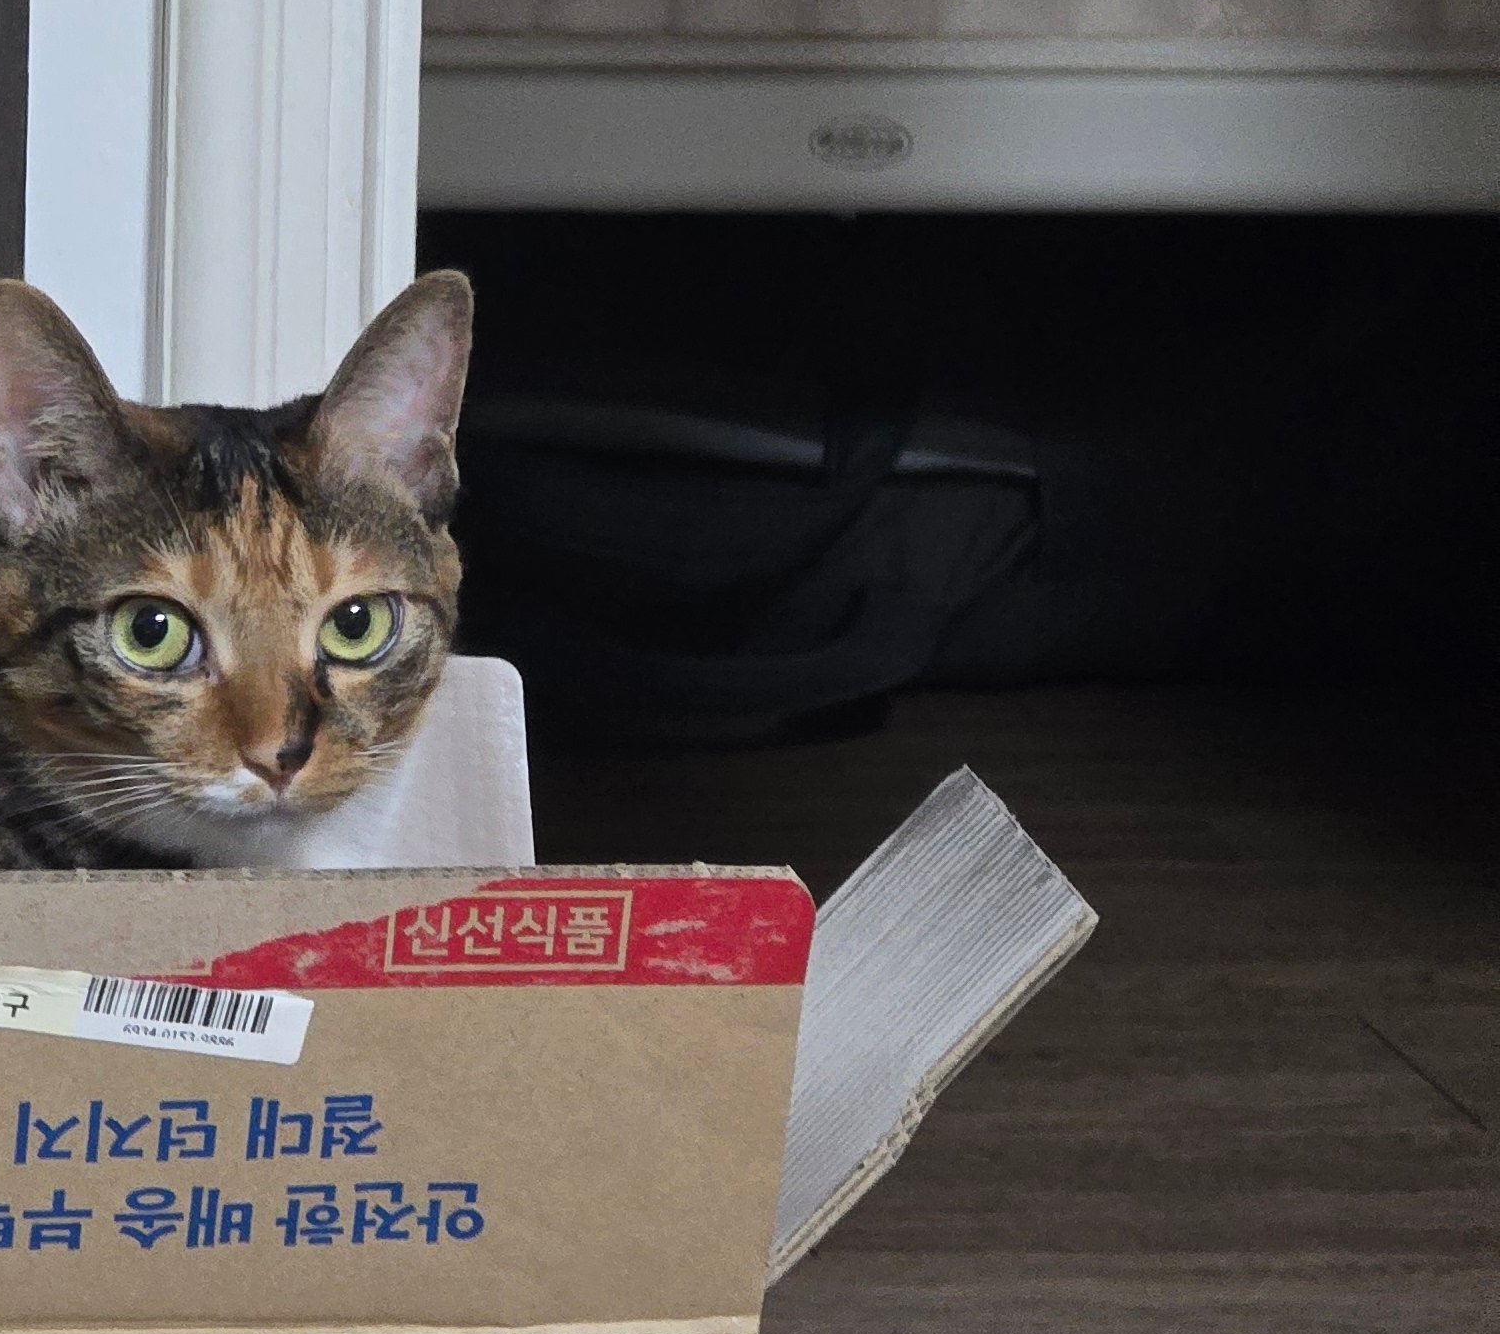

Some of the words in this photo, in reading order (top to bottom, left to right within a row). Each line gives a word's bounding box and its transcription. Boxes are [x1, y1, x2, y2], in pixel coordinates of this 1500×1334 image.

[403, 903, 613, 957] 신선식품
[15, 1100, 215, 1163] 던지지
[247, 1094, 380, 1158] 절대
[115, 1187, 252, 1247] 배송
[276, 1182, 485, 1244] 안전한
